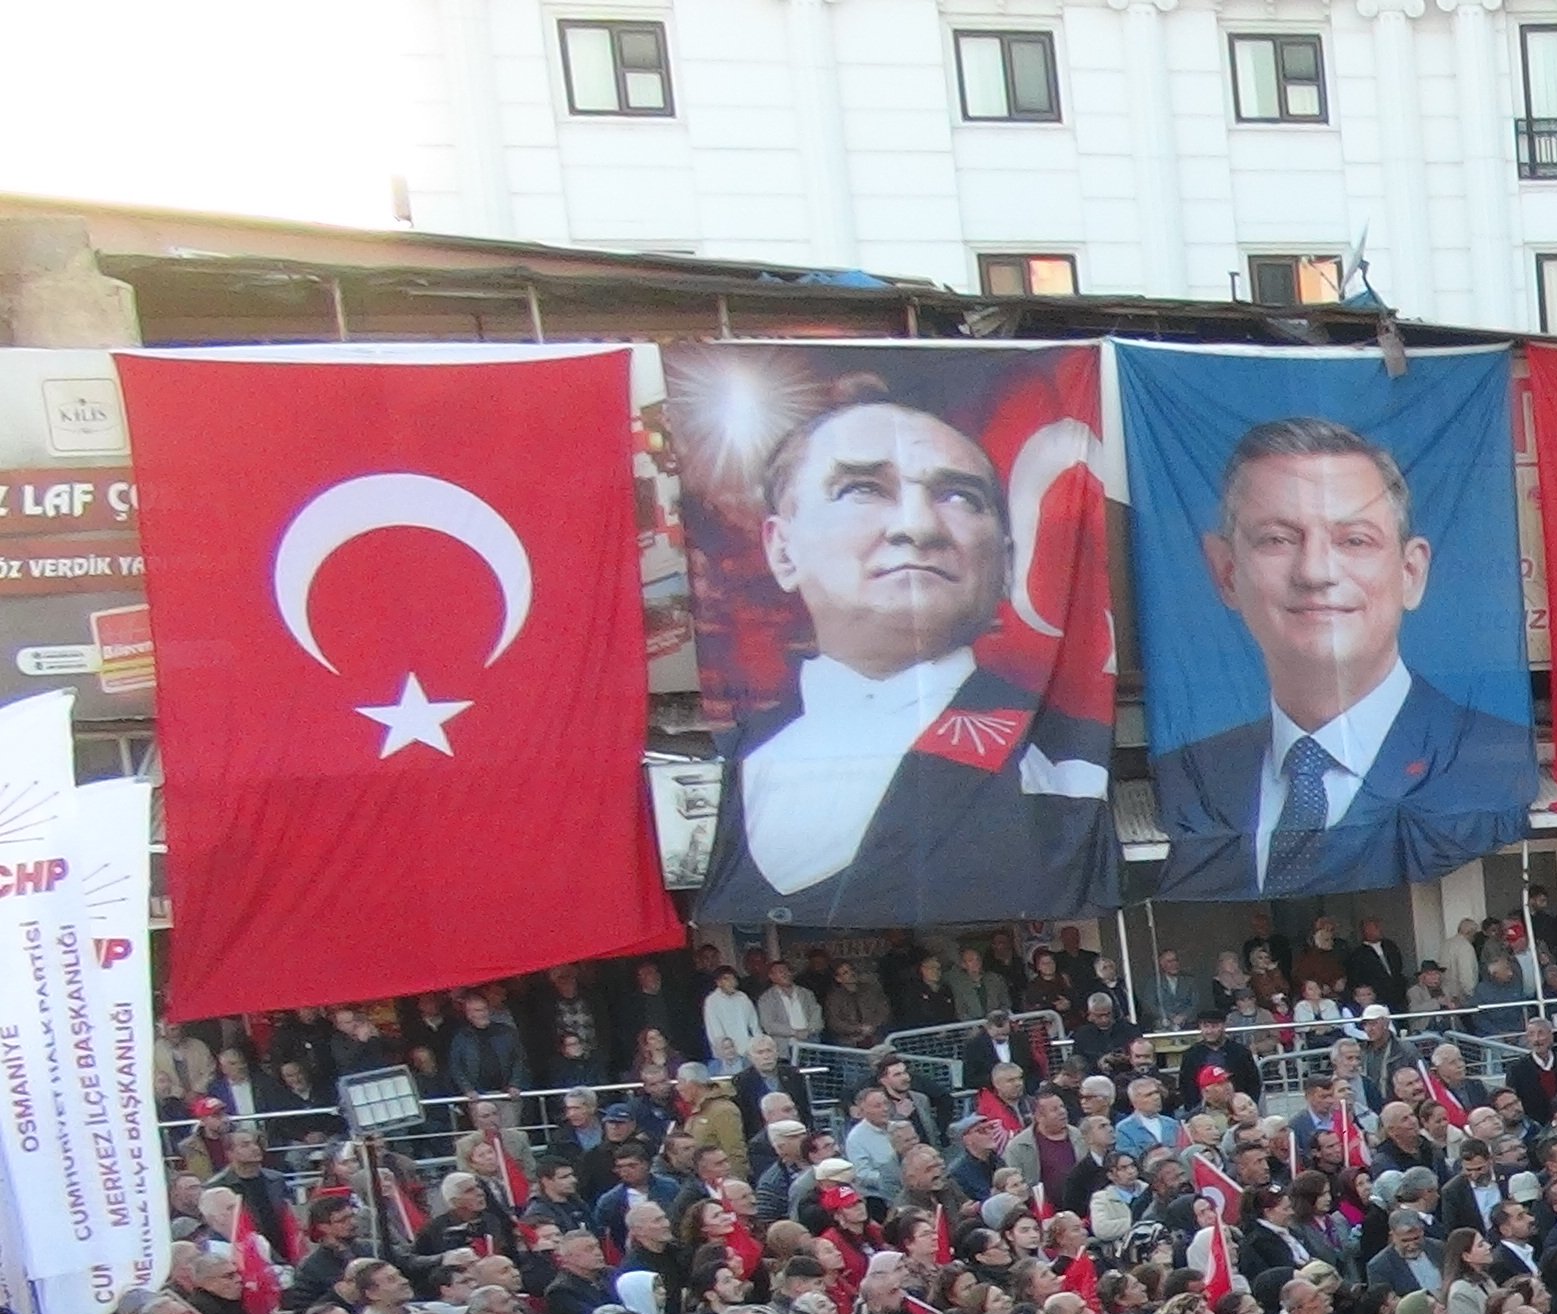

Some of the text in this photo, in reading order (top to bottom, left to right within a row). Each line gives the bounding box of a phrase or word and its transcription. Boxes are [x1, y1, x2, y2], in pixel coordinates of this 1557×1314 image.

[23, 483, 95, 518] LAF
[28, 554, 112, 578] VERDİK
[56, 924, 97, 1070] BAŞKANLIĞI
[1, 1024, 39, 1152] OSMANİYE
[93, 1130, 131, 1228] MERKEZ
